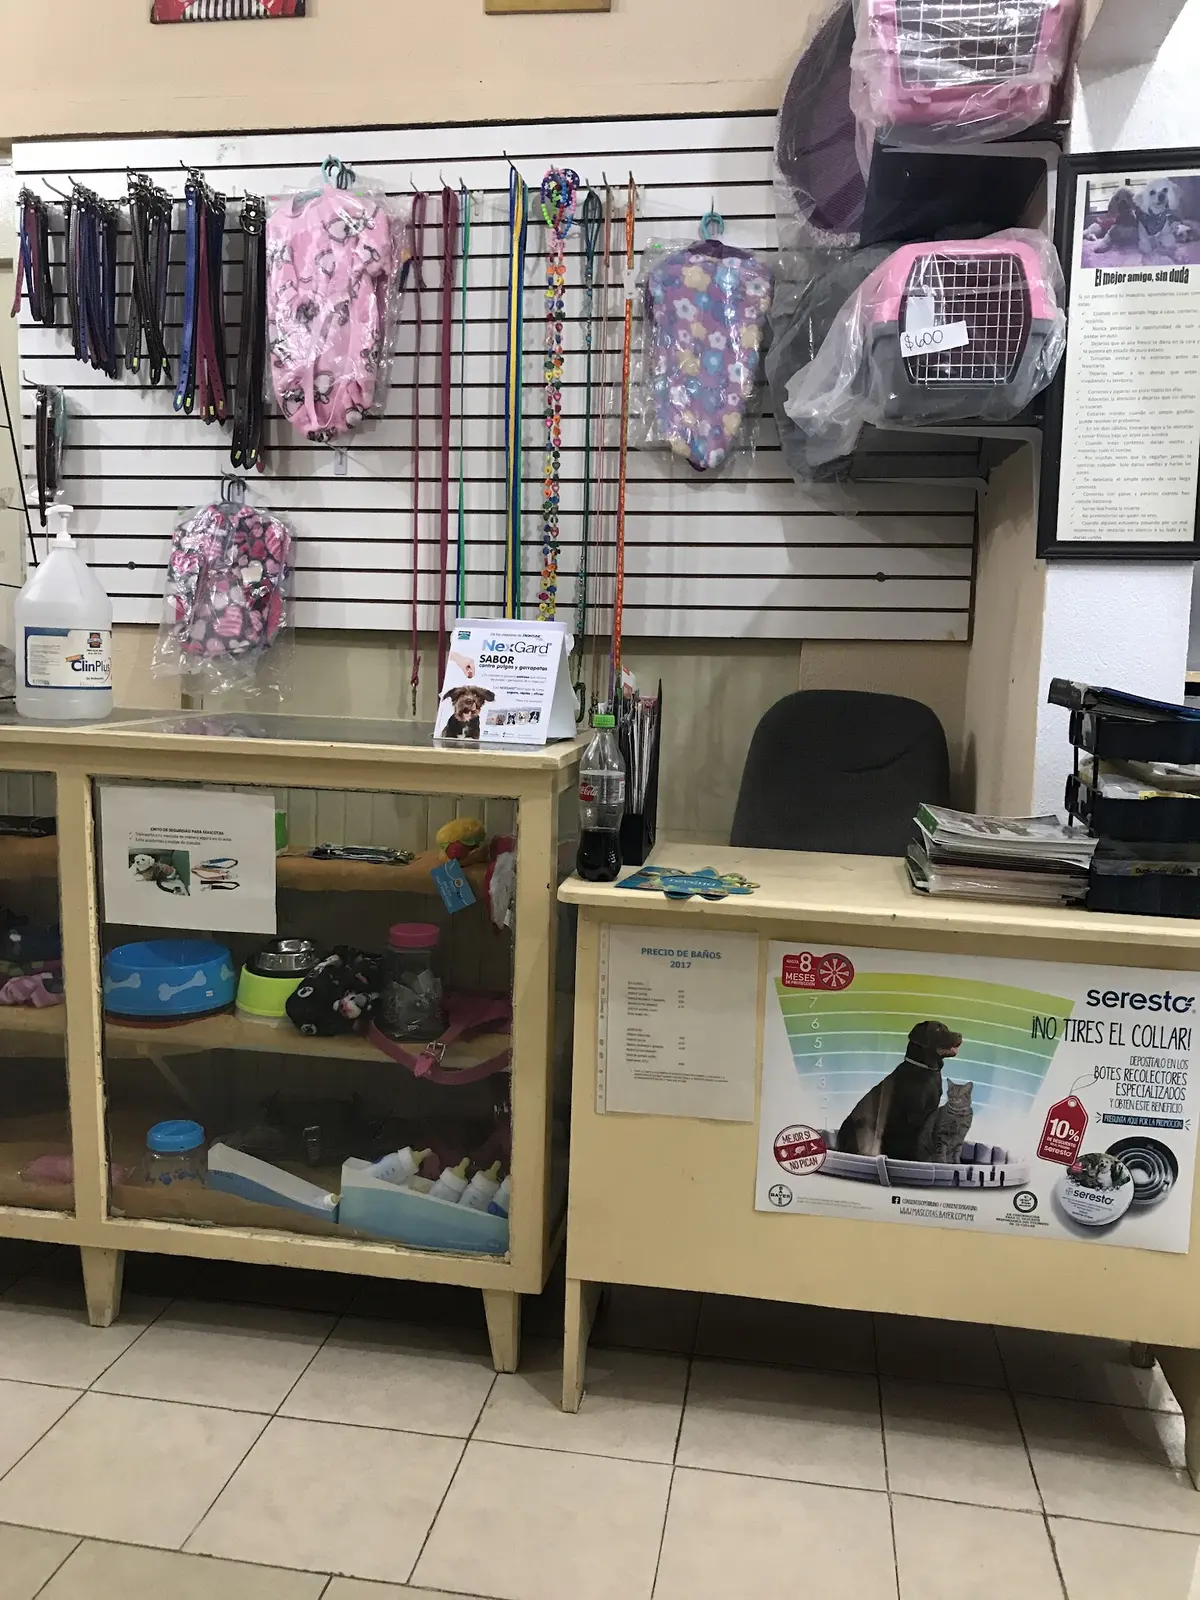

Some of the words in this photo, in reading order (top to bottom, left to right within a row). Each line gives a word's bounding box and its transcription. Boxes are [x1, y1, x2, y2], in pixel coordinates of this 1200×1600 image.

[1094, 268, 1102, 287] El
[1102, 271, 1126, 285] mejor
[1127, 272, 1154, 282] amigo,
[1155, 270, 1168, 282] sin
[1169, 266, 1189, 284] duda
[904, 330, 943, 351] $600
[480, 654, 514, 664] SABOR
[641, 948, 674, 957] PRECIO
[677, 950, 688, 958] DE
[691, 950, 721, 959] BAÑOS
[670, 961, 691, 969] 2017
[800, 953, 811, 972] 8
[786, 972, 815, 981] MESES
[809, 996, 818, 1008] 7
[811, 1017, 820, 1029] 6
[1032, 1016, 1057, 1040] ¡NO
[1063, 1018, 1105, 1044] TIRES
[1109, 1023, 1126, 1046] EL
[1132, 1024, 1192, 1051] COLLAR!
[814, 1037, 822, 1049] 5
[814, 1057, 823, 1068] 4
[1167, 1059, 1176, 1069] EN
[1177, 1059, 1188, 1069] LOS
[1094, 1066, 1121, 1081] BOTES
[1124, 1068, 1187, 1086] RECOLECTORES
[818, 1077, 825, 1088] 3
[1116, 1083, 1186, 1100] ESPECIALIZADOS
[1135, 1100, 1150, 1111] ESTE
[1103, 1115, 1126, 1123] PREGUNTA
[1050, 1118, 1079, 1141] 10%
[782, 1132, 804, 1144] MEJOR
[789, 1161, 799, 1170] NO
[800, 1157, 818, 1169] PICAN
